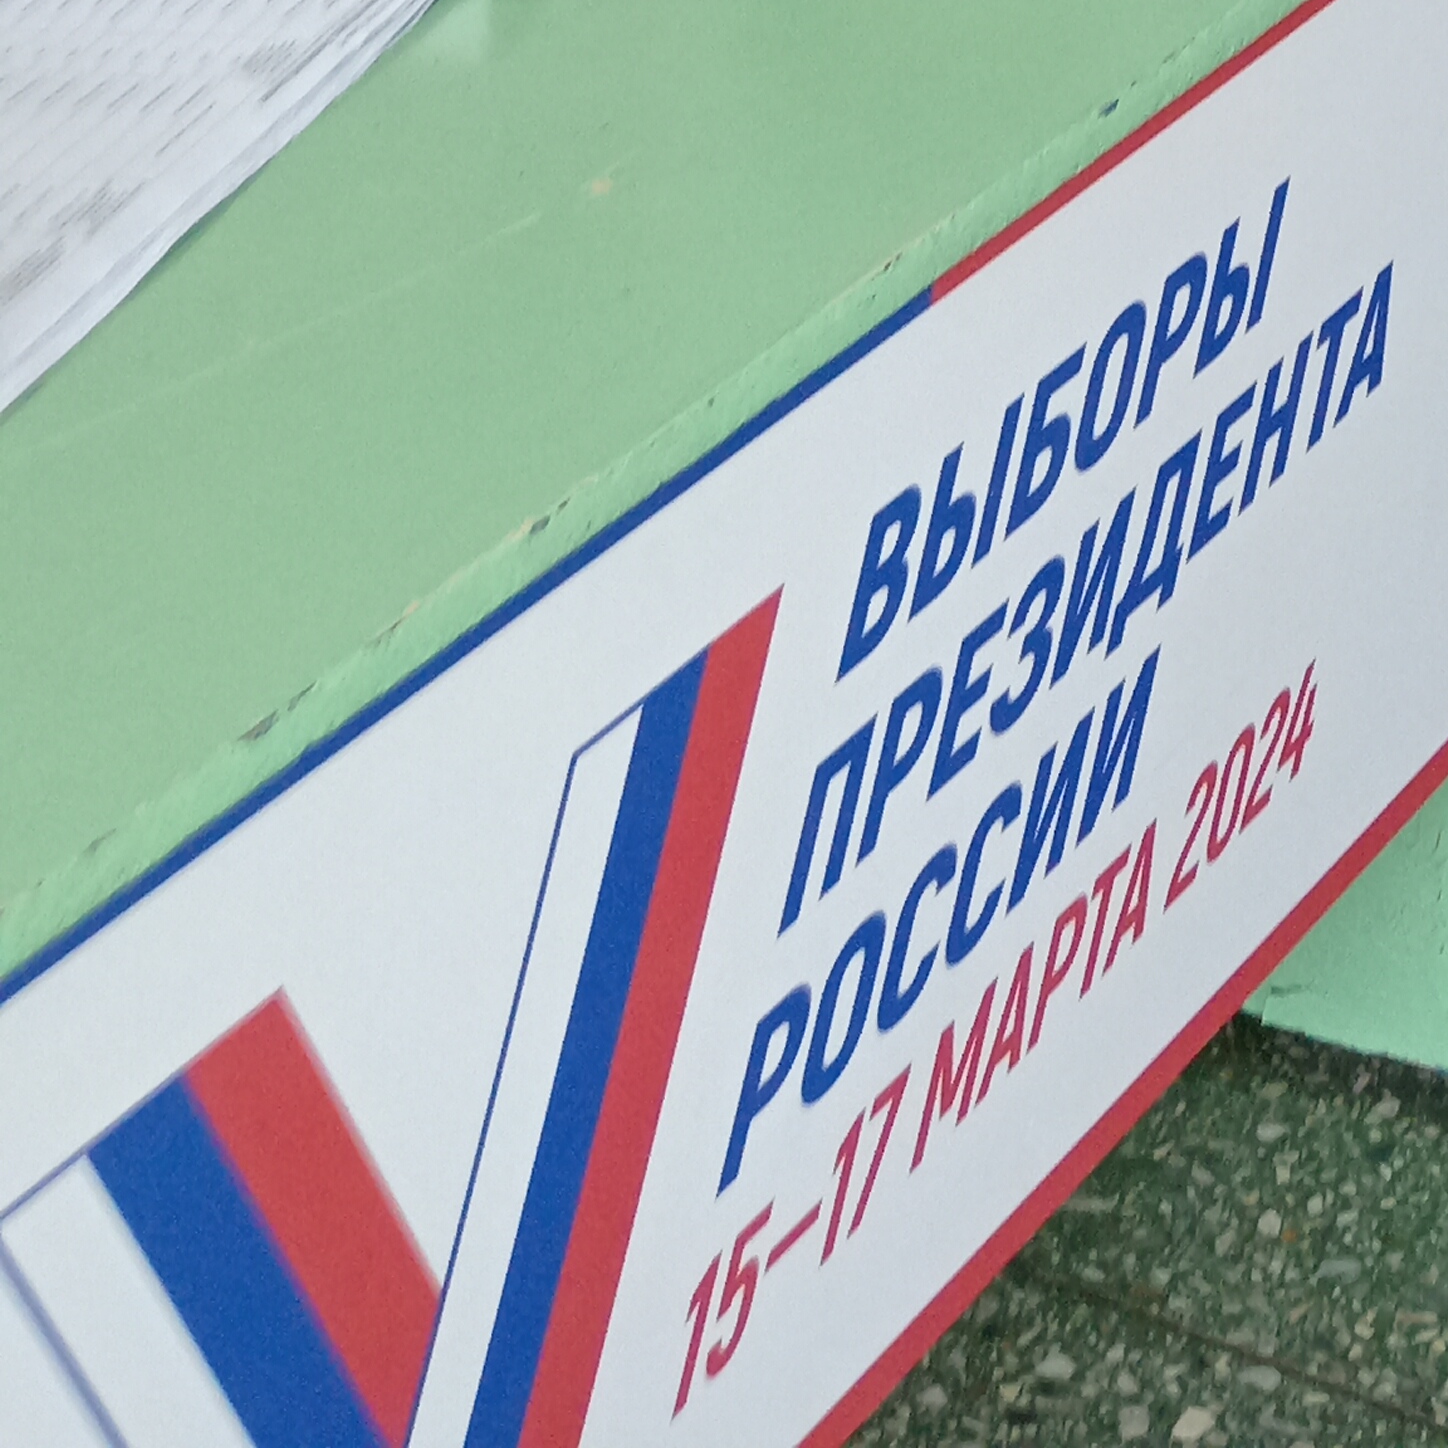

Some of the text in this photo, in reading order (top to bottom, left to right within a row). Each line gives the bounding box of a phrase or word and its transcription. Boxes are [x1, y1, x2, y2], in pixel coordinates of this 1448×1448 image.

[776, 260, 1396, 935] ПРЕЗИДЕНТА
[836, 176, 1291, 683] ВЫБОРЫ
[716, 644, 1161, 1198] РОССИИ
[910, 821, 1158, 1172] МАРТА
[1164, 660, 1319, 912] 2024
